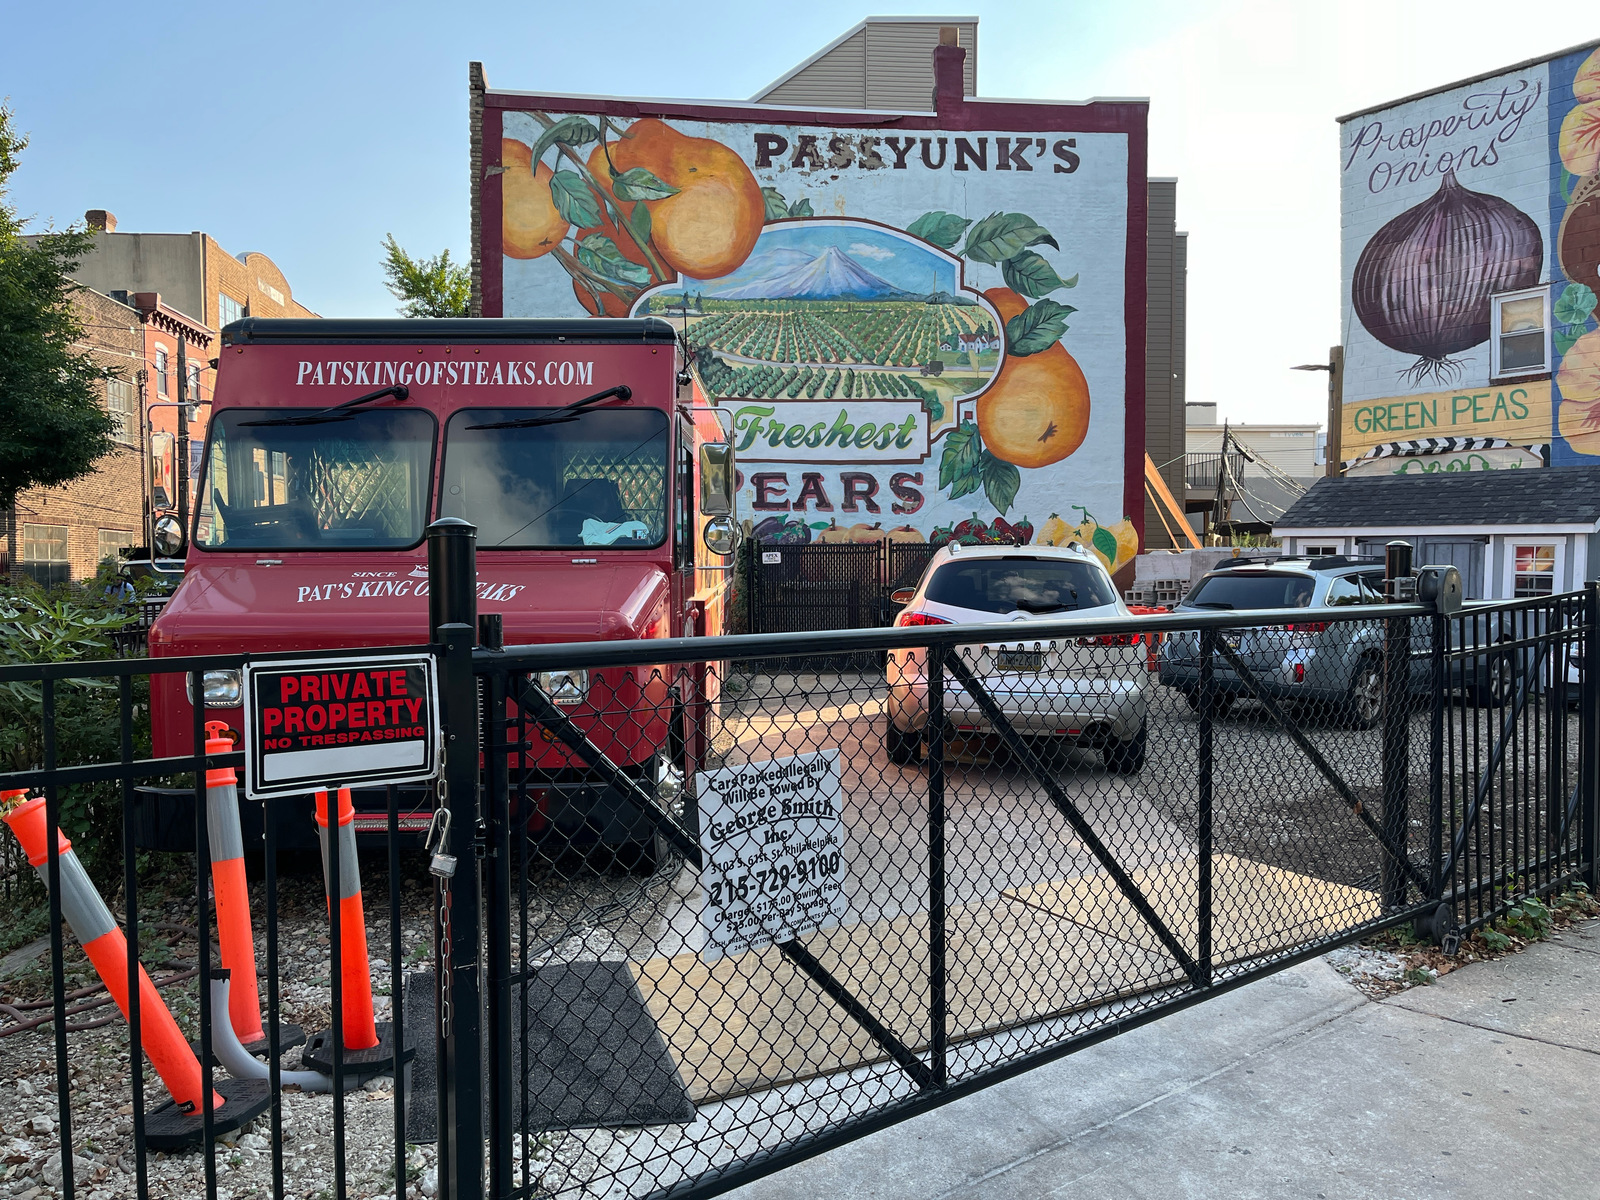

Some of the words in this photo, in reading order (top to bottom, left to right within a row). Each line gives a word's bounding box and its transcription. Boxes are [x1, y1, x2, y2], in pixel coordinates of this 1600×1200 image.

[1344, 80, 1541, 171] Prosperity
[753, 132, 1081, 174] PASSYUNK'S
[295, 361, 594, 386] PATSKINGOFSTEAKS.COM
[1354, 400, 1438, 434] GREEN
[1452, 388, 1529, 426] PEAS
[734, 406, 917, 451] Freshest
[296, 581, 356, 603] PAT'S
[356, 580, 413, 598] KING
[414, 580, 429, 596] O
[280, 670, 408, 704] PRIVATE
[263, 698, 423, 735] PROPERTY
[264, 737, 292, 750] NO
[299, 726, 426, 747] TRESPASSING
[709, 775, 738, 791] Cars
[740, 766, 784, 786] Parked
[785, 758, 831, 778] Illegally
[723, 787, 747, 805] Will
[749, 787, 766, 800] Be
[769, 777, 804, 795] Towed
[807, 776, 820, 790] By
[709, 805, 777, 841] George
[781, 797, 833, 817] Smith
[764, 829, 792, 845] Inc.
[711, 859, 735, 875] 3103
[748, 853, 768, 866] 61st
[785, 834, 838, 857] Philadelphia
[709, 850, 840, 907] 215-729-9100
[823, 881, 839, 894] Fee
[796, 896, 829, 913] Storage
